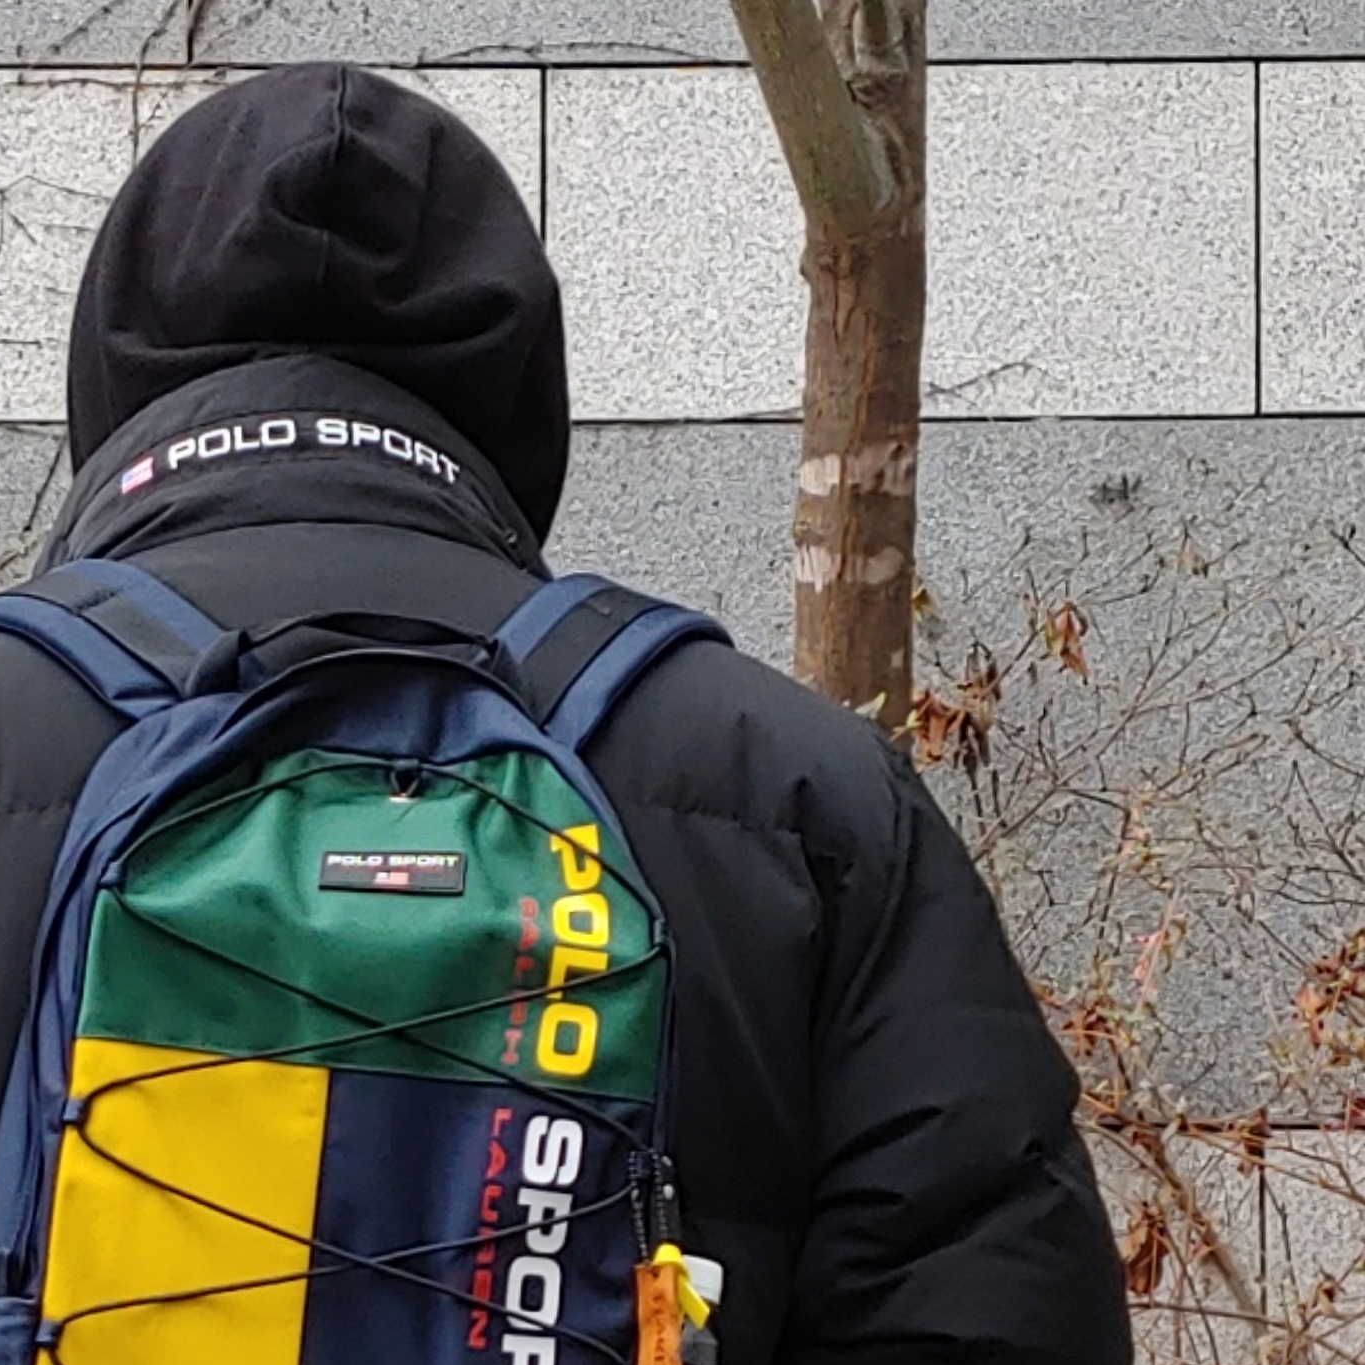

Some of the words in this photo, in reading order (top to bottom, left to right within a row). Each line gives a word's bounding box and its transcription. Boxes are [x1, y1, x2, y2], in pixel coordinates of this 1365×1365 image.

[168, 418, 297, 469] POLO
[316, 418, 461, 484] SPORT
[327, 854, 383, 866] POLO
[389, 854, 459, 867] SPORT
[536, 822, 610, 1077] POLO
[466, 1108, 513, 1350] LAUREN
